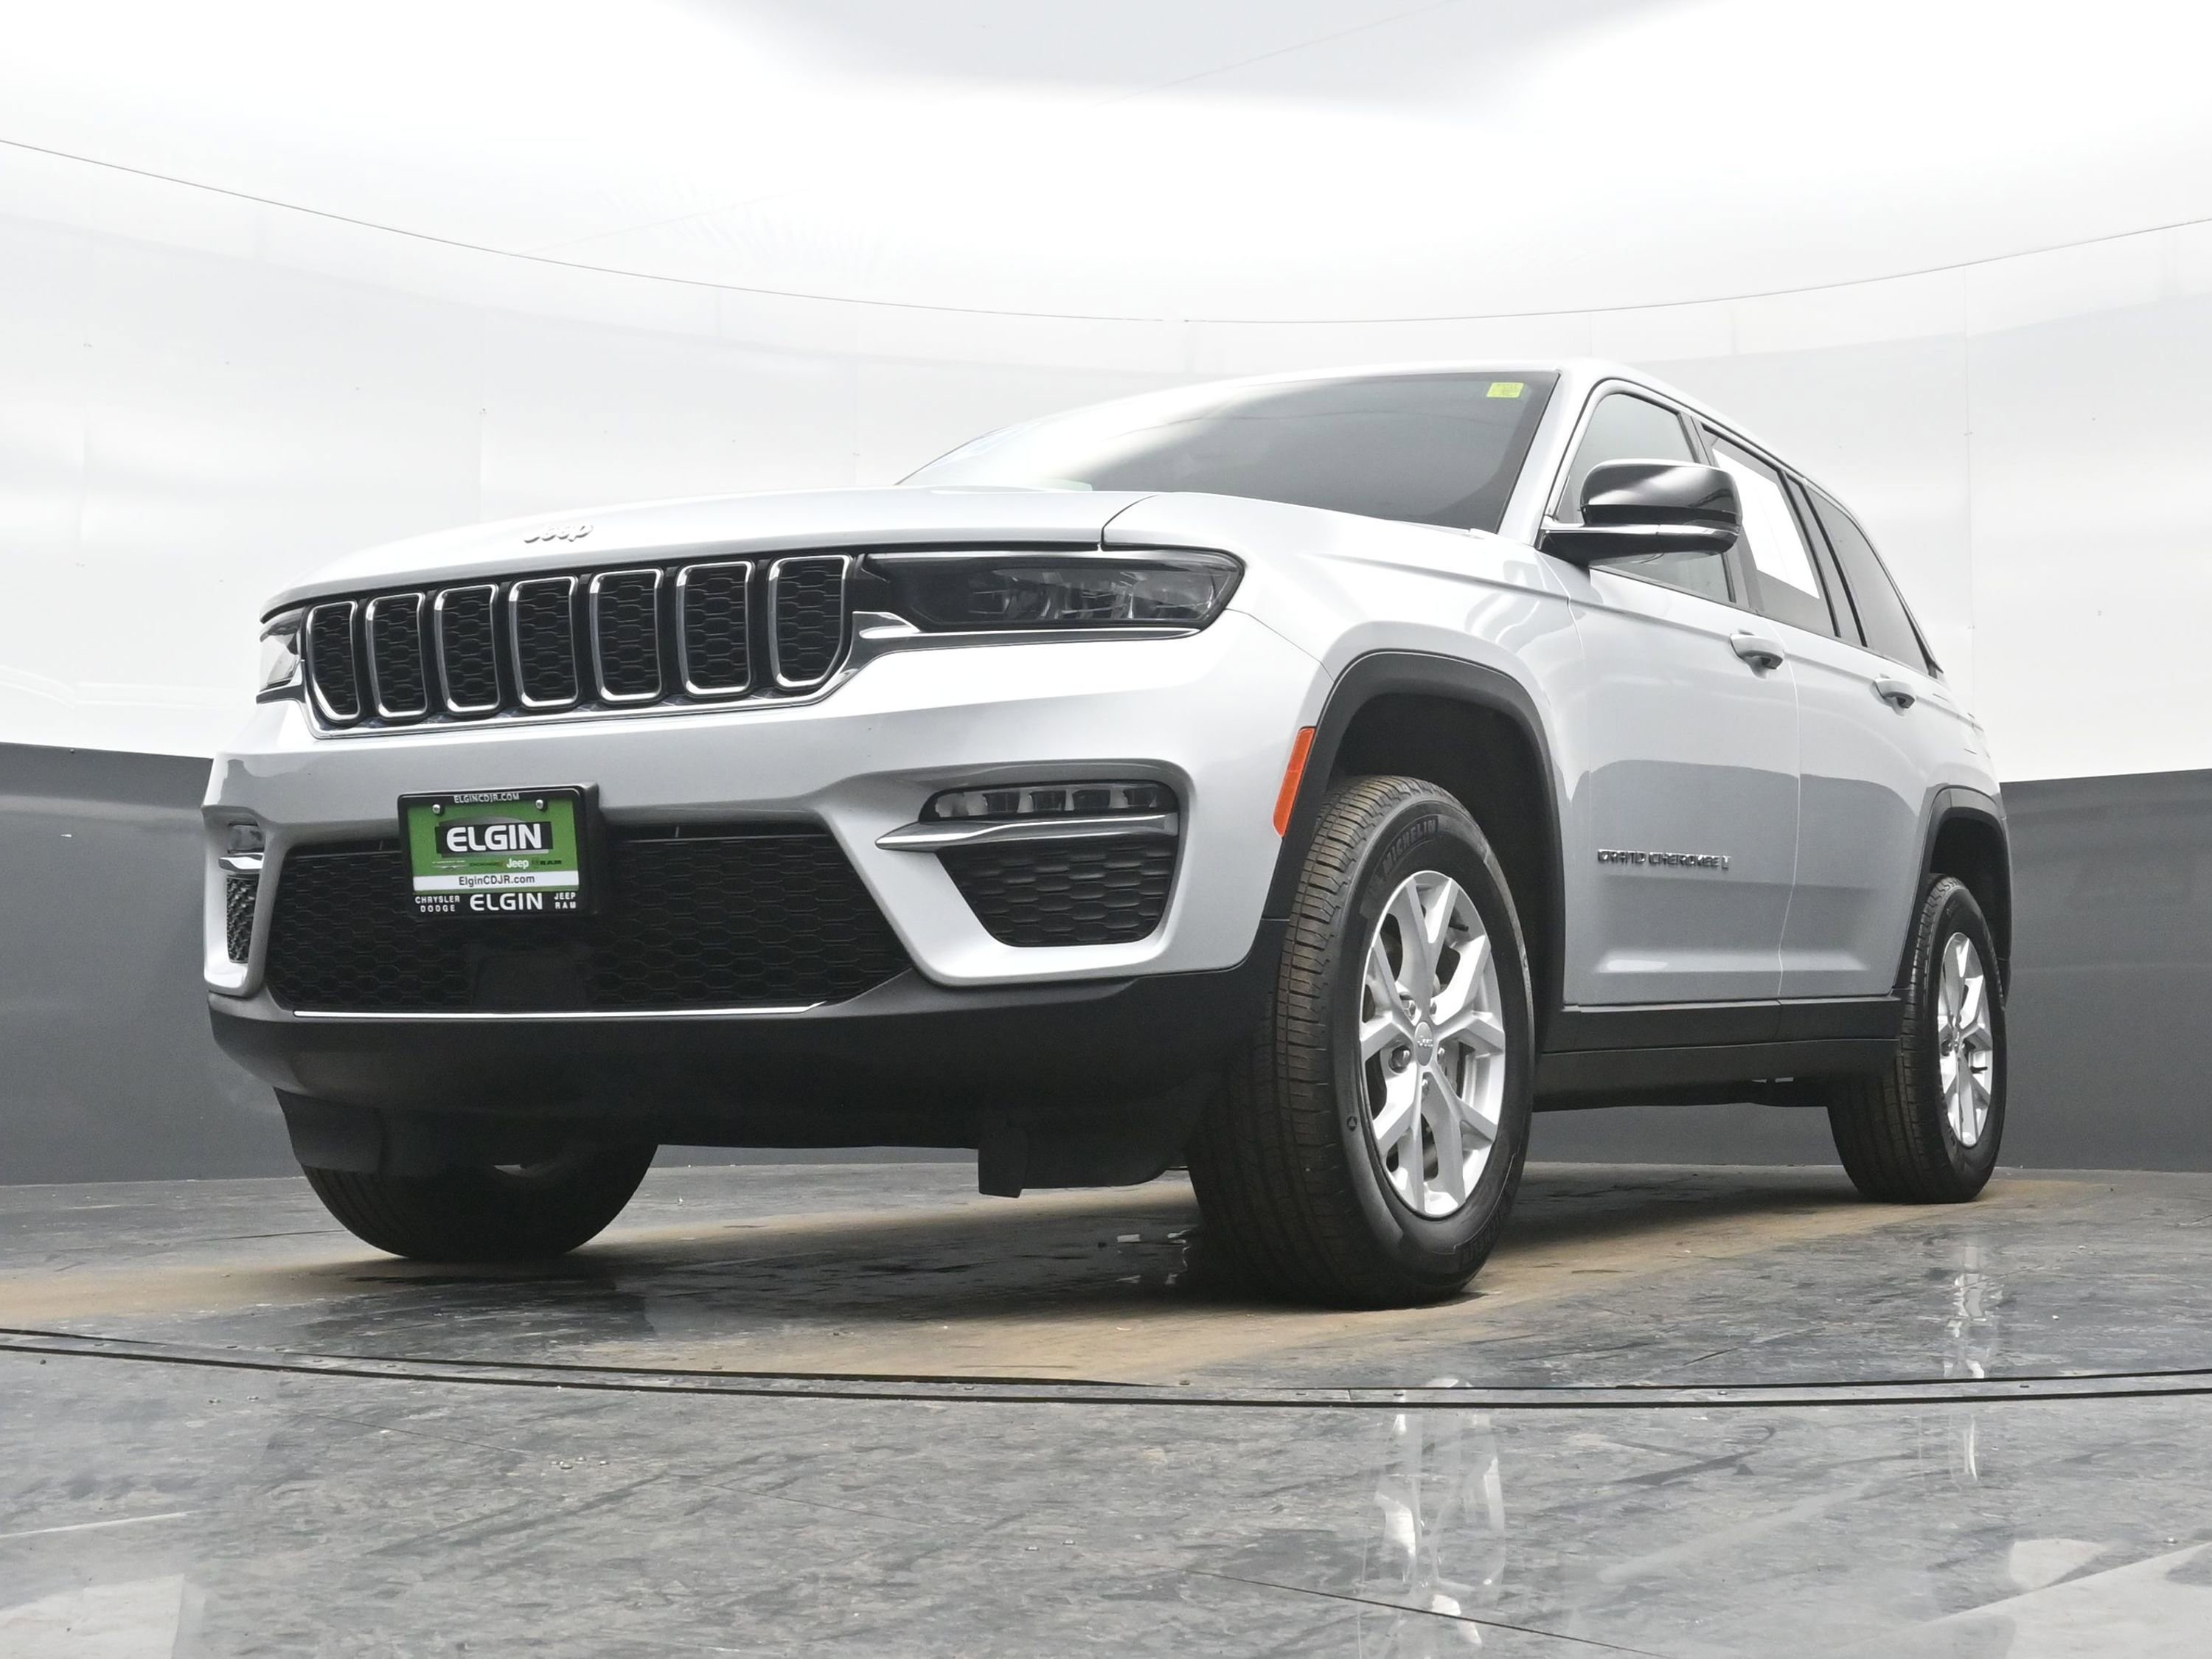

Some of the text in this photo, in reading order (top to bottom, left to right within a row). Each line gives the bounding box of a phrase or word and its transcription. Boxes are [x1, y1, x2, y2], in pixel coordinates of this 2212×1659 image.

[522, 522, 594, 544] Jeep
[453, 793, 520, 804] ELGINCDJR.COM
[446, 823, 543, 852] ELGIN
[1381, 818, 1437, 876] MICHELIN
[507, 858, 529, 869] Jeep
[459, 875, 535, 887] ElginCDJR.com
[415, 895, 460, 904] CHRYSLER
[470, 892, 543, 911] ELGIN
[554, 892, 577, 900] JEEP
